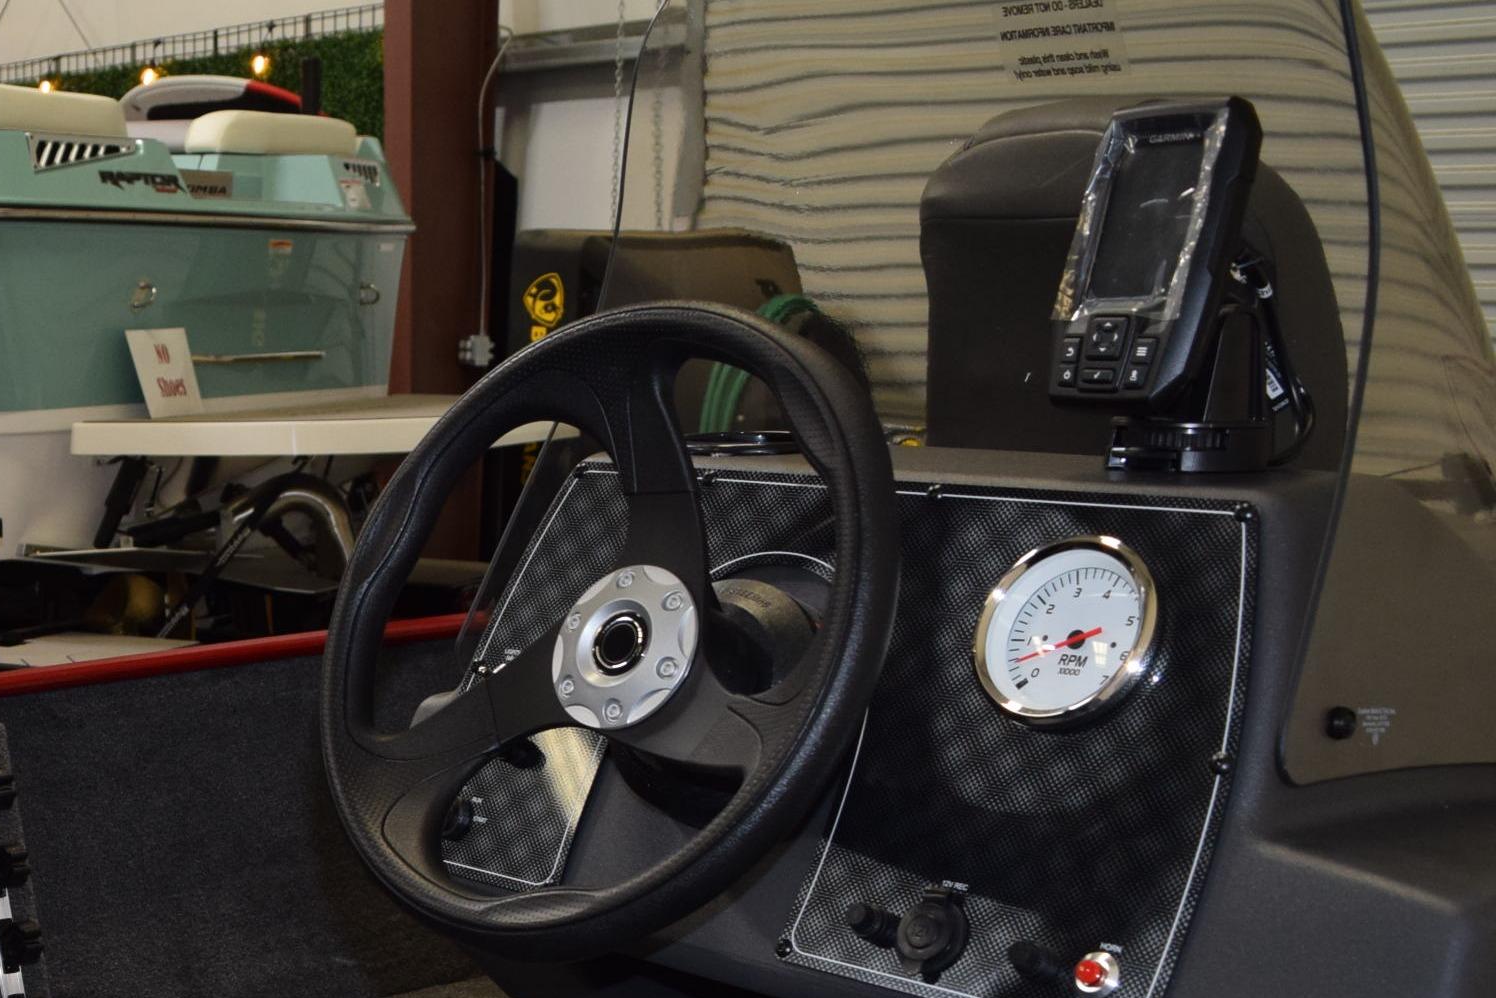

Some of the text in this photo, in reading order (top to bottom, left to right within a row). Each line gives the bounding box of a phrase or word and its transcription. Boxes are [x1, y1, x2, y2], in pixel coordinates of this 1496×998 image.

[1149, 132, 1194, 143] GARMIN
[98, 170, 187, 193] RAPTOR
[154, 344, 171, 365] NO
[156, 377, 188, 398] Shoes
[1073, 587, 1083, 599] 3
[1102, 589, 1112, 600] 4
[1046, 604, 1055, 615] 2
[1125, 615, 1135, 627] 5
[1057, 653, 1088, 668] RPM
[1119, 650, 1129, 662] 6
[1030, 667, 1040, 678] 0
[1099, 675, 1109, 686] 7
[953, 881, 969, 891] REC
[1099, 942, 1122, 953] HORN
